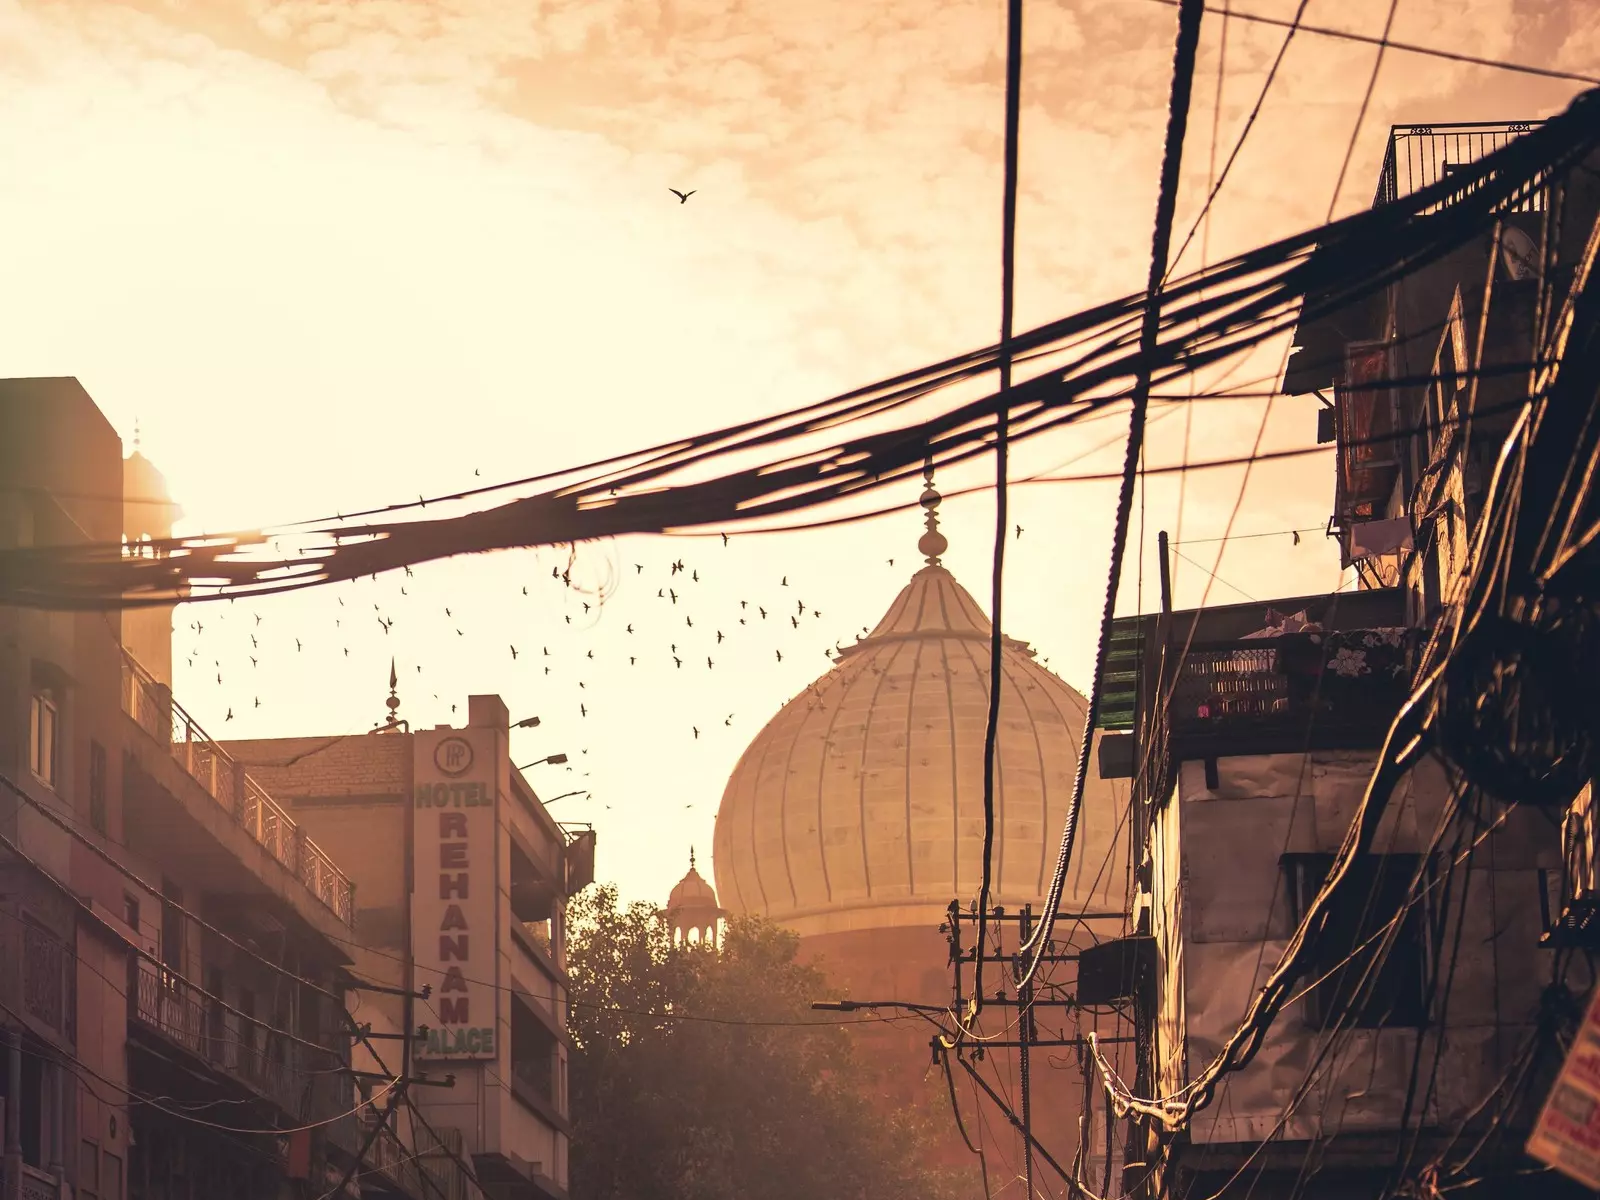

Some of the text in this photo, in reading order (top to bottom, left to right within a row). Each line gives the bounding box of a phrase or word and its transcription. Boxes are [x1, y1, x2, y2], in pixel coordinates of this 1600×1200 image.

[415, 782, 494, 809] HOTEL
[439, 811, 470, 1024] REHANAM
[414, 1027, 494, 1054] PALACE
